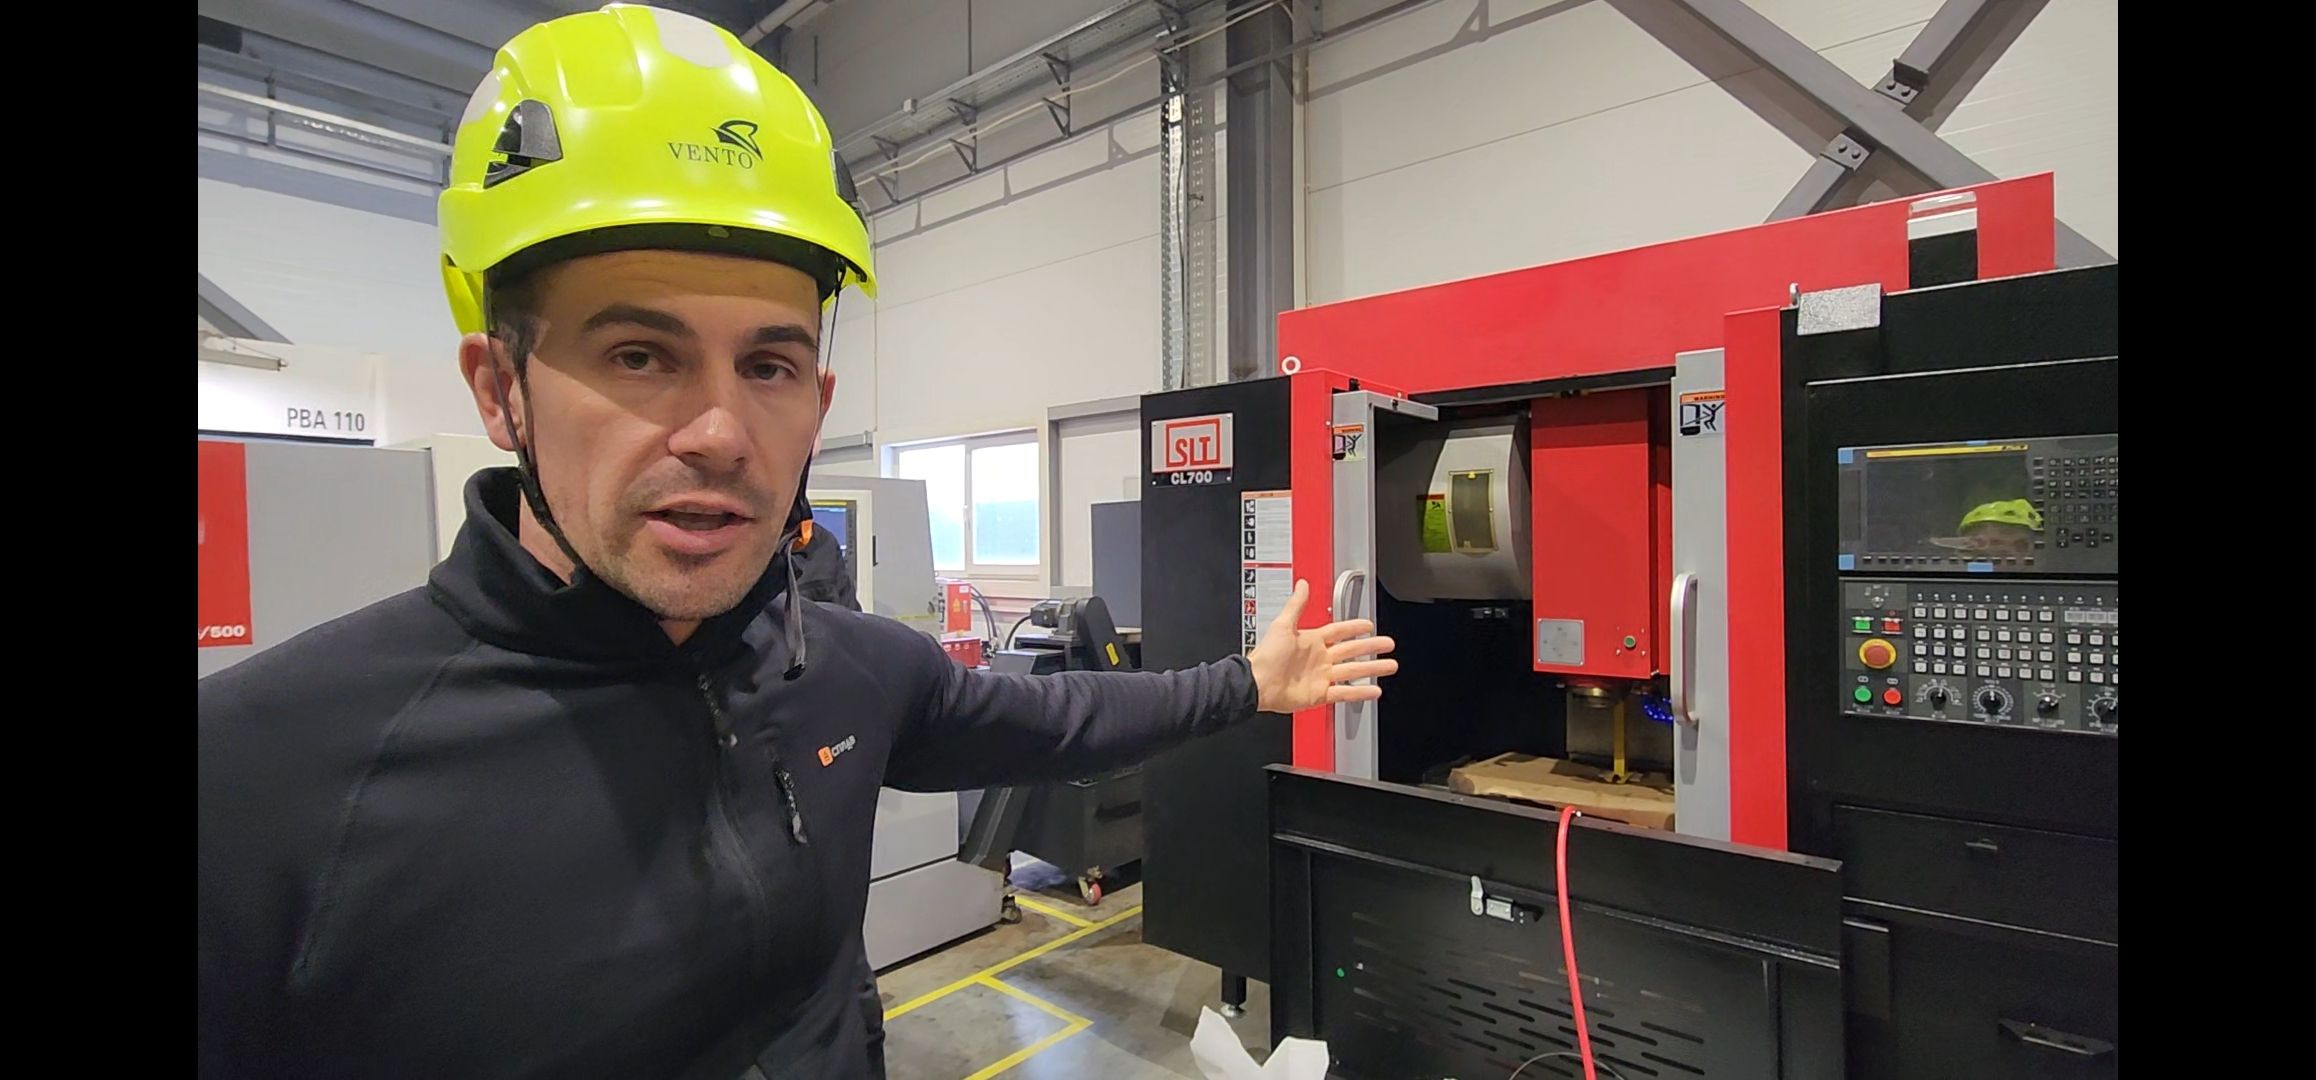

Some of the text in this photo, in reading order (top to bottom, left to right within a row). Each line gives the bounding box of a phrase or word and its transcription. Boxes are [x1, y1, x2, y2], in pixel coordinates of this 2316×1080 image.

[668, 142, 753, 169] VENTO
[287, 407, 365, 431] PBA 110
[1175, 436, 1212, 467] SLT
[1170, 470, 1213, 485] CL700
[198, 625, 246, 640] /500
